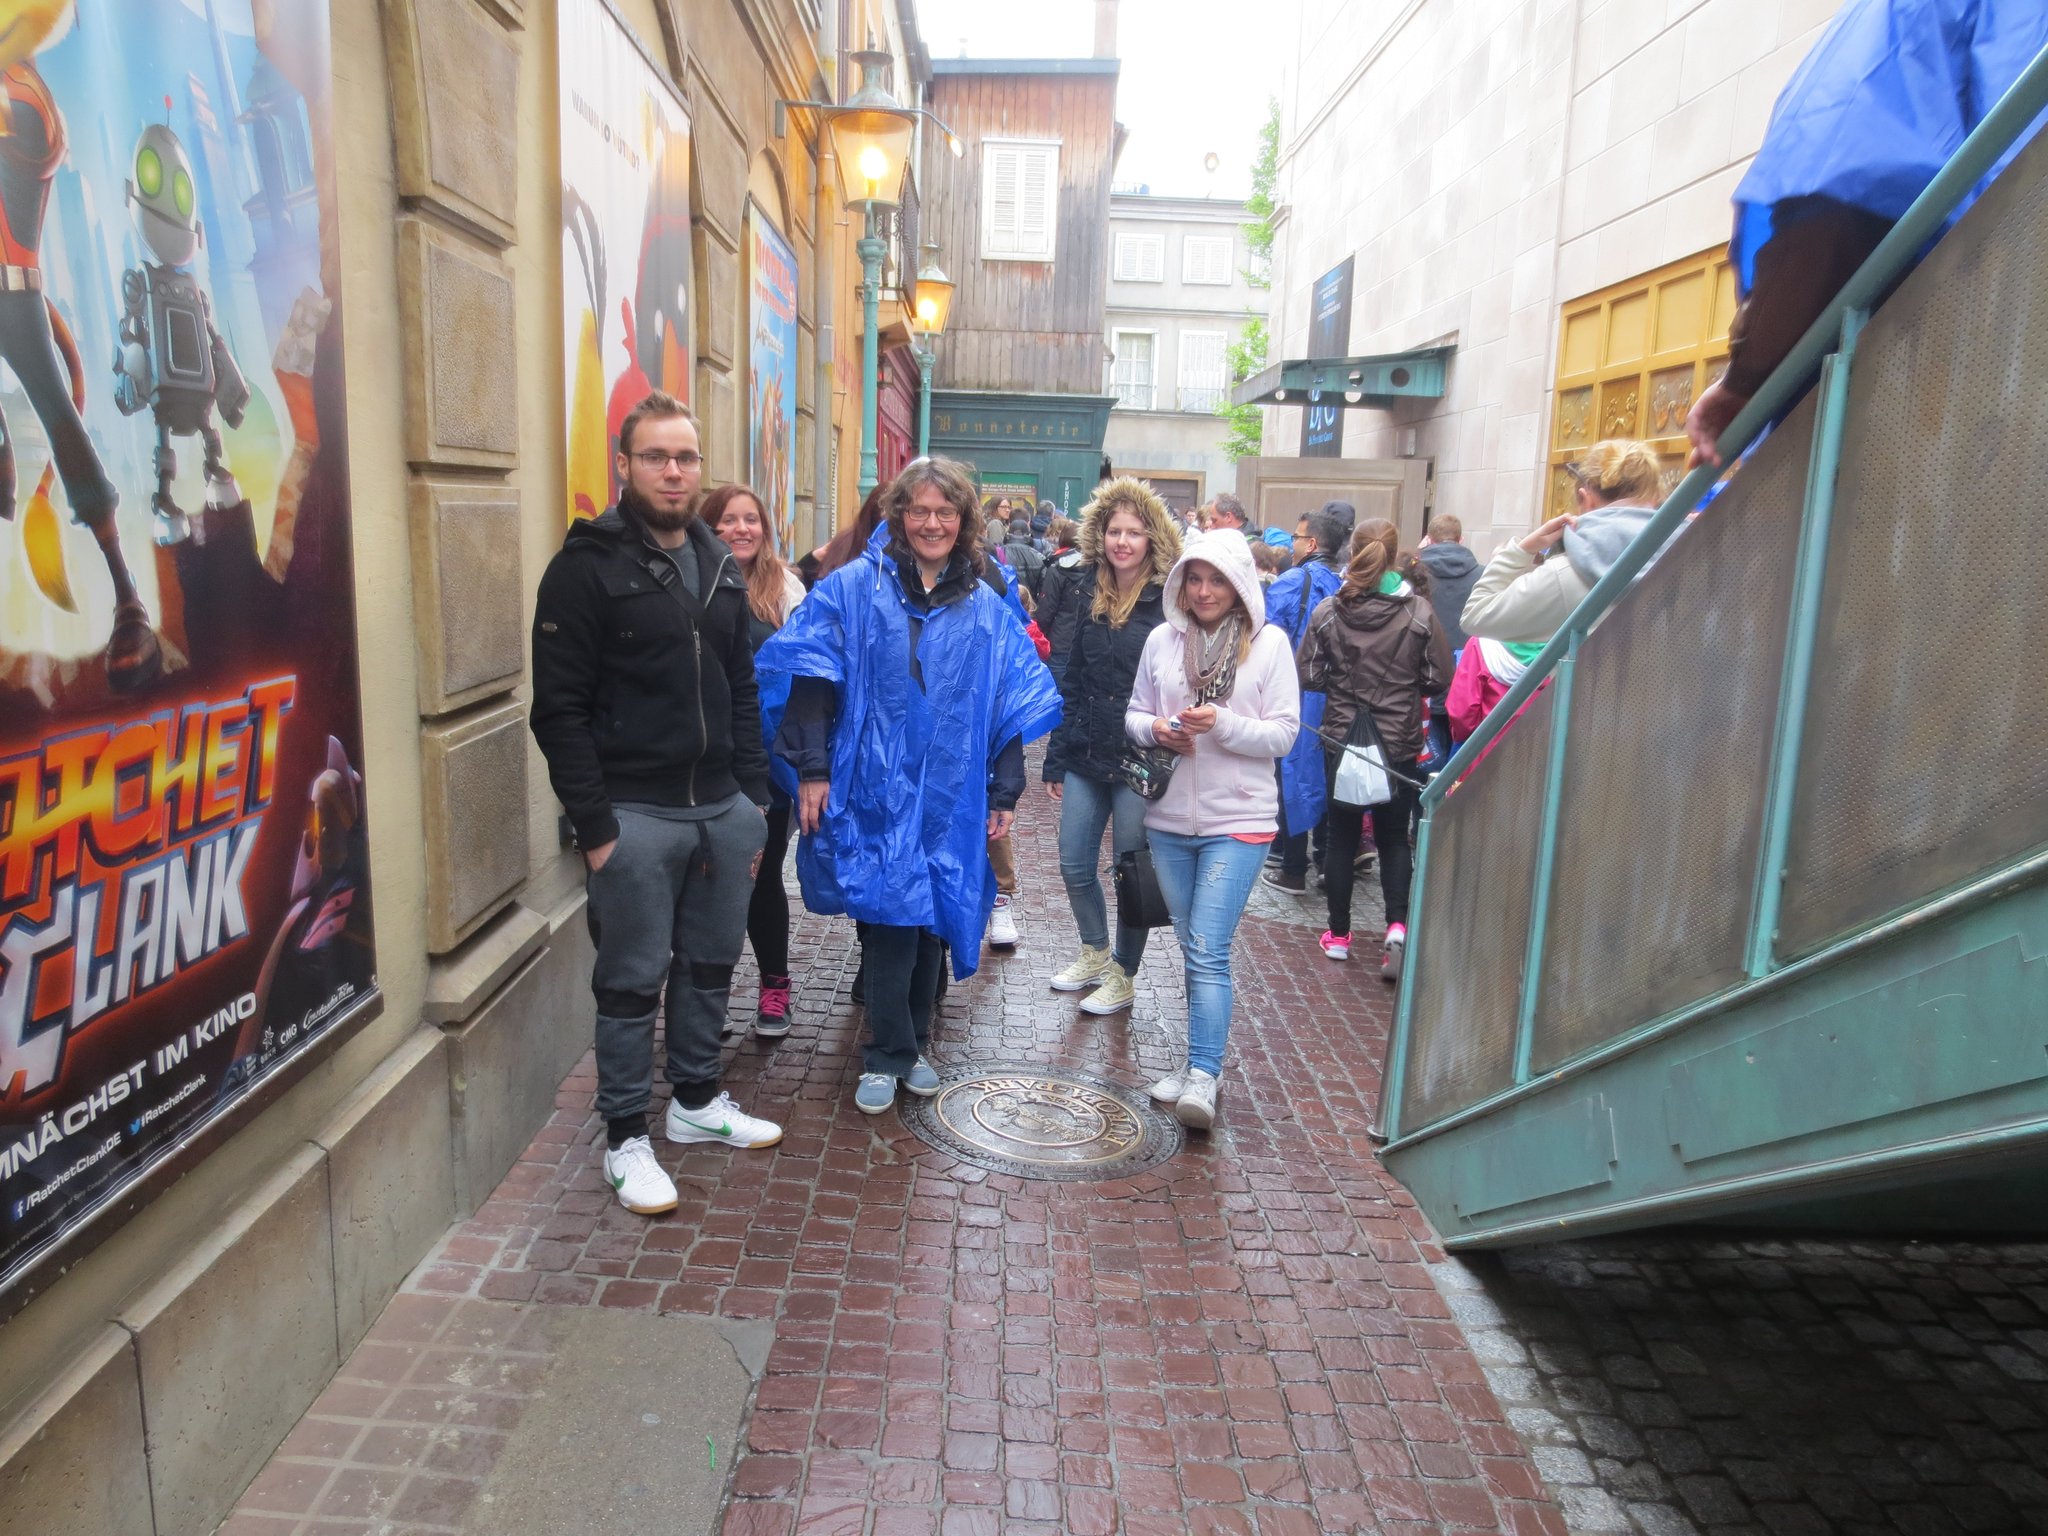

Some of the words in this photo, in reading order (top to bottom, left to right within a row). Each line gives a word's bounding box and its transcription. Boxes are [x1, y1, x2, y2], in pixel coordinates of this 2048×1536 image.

[934, 415, 1079, 437] Bonneterie
[157, 1034, 189, 1076] IM
[195, 991, 257, 1049] KINO
[280, 1023, 297, 1045] CMG
[968, 1078, 1136, 1147] EUROPA-PARK
